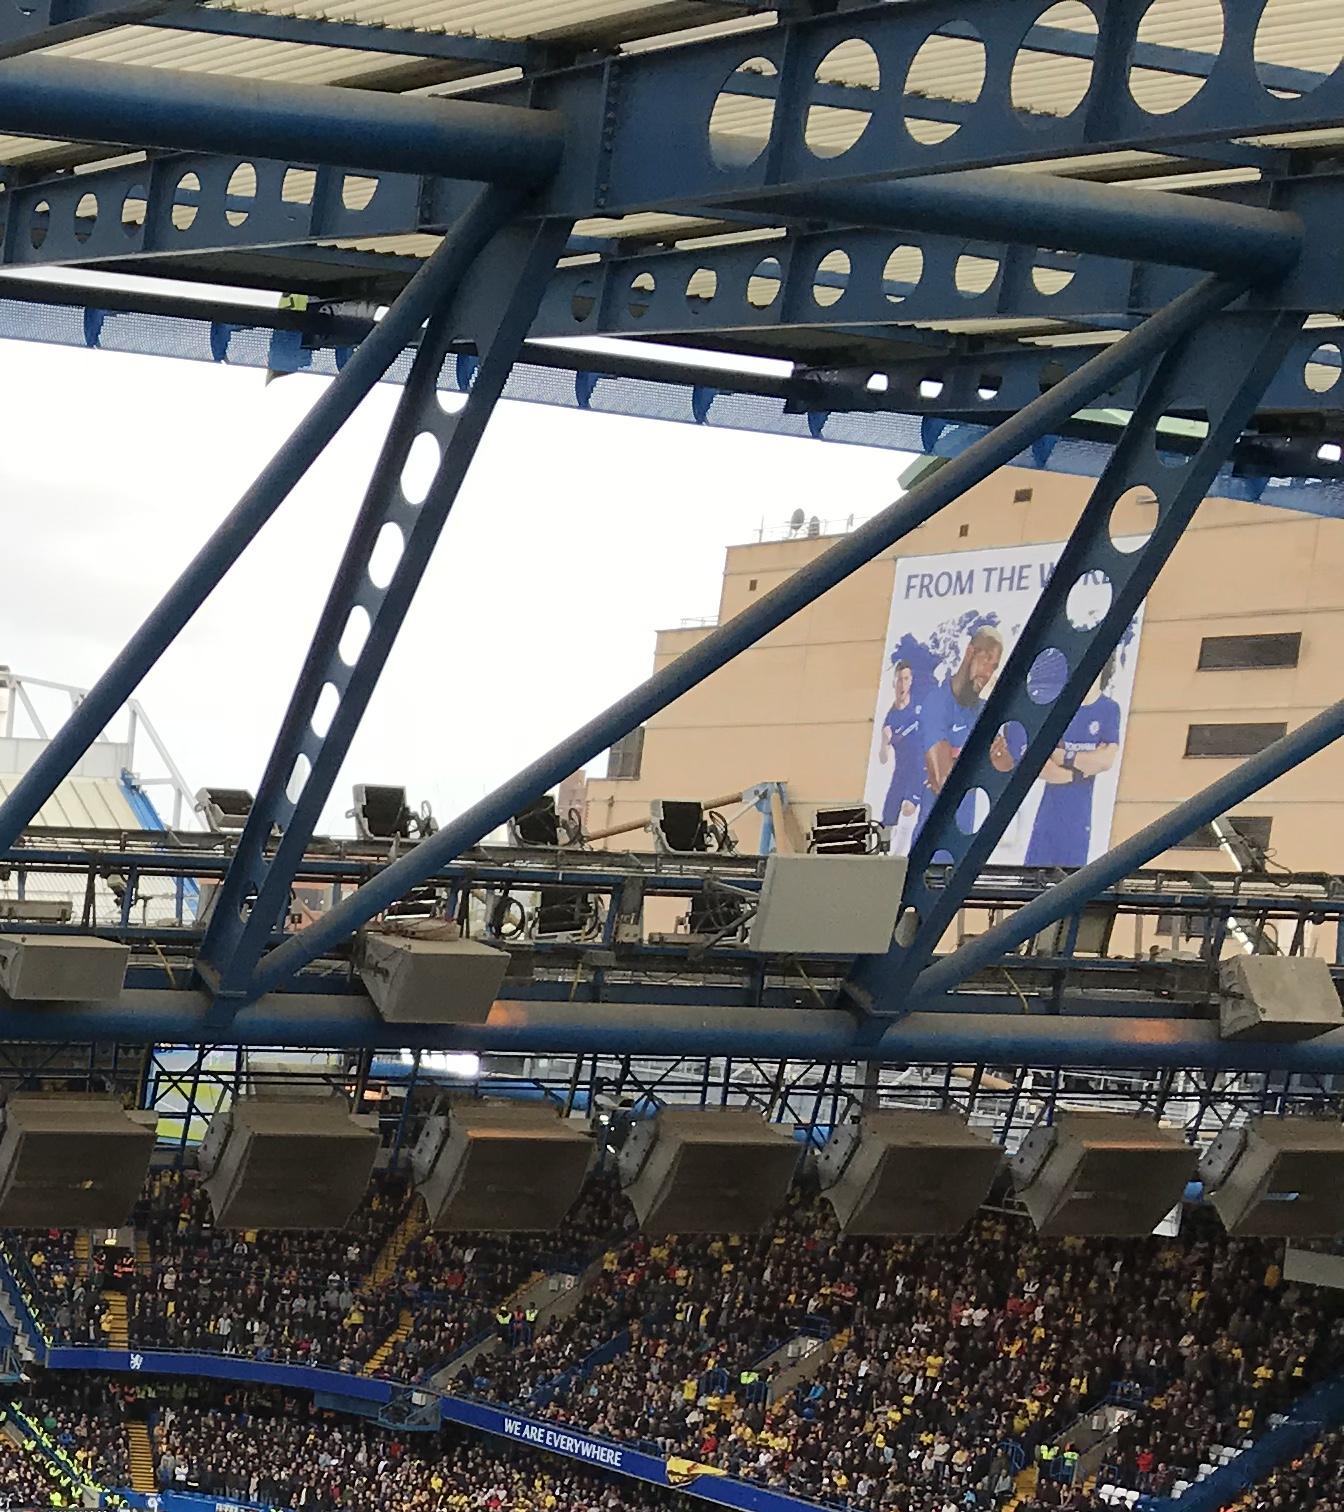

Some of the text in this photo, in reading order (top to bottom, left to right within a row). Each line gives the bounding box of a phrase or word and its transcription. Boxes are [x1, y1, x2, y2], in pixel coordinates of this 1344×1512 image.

[904, 569, 975, 600] FROM
[983, 563, 1033, 594] THE
[504, 1417, 623, 1466] WE ARE EVERYWHERE
